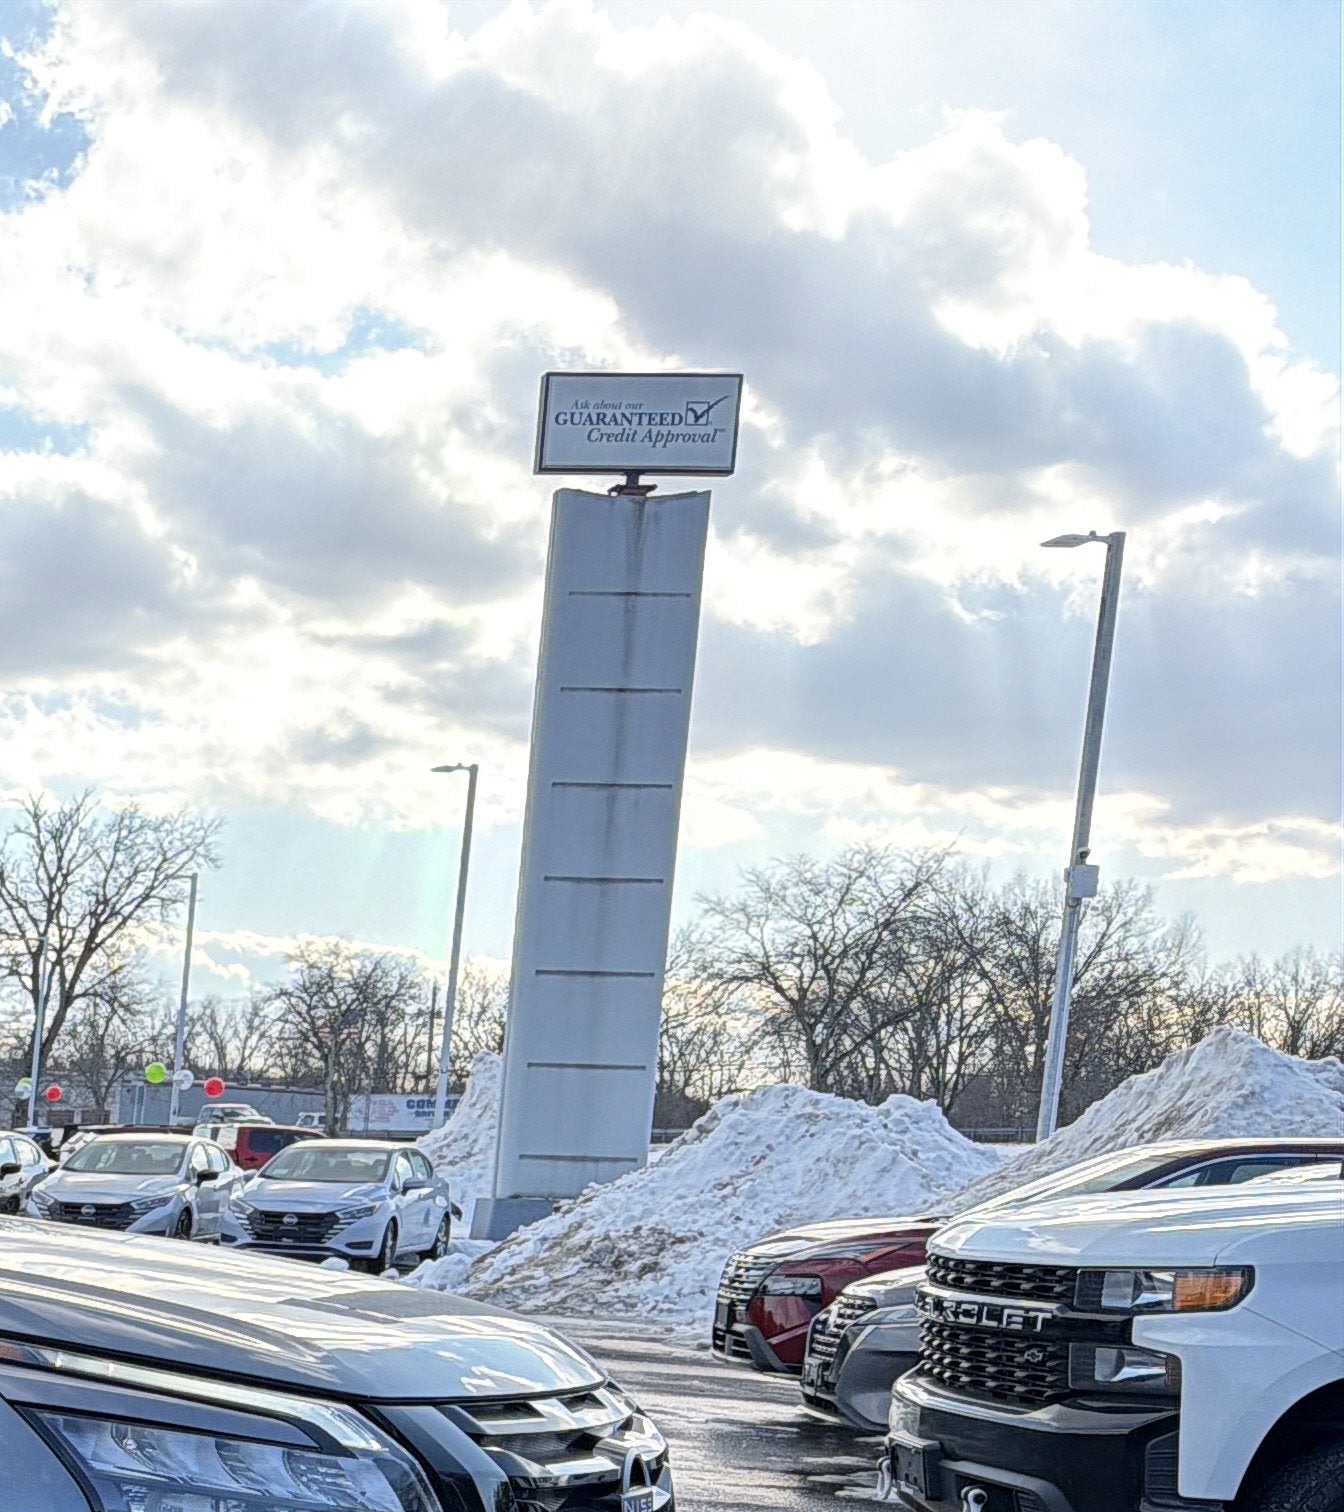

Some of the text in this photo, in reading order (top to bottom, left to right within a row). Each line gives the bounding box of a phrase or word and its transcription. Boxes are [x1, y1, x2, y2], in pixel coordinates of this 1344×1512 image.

[571, 399, 643, 410] Ask about our
[554, 411, 684, 427] GUARANTEED
[586, 427, 719, 449] Credit Approval
